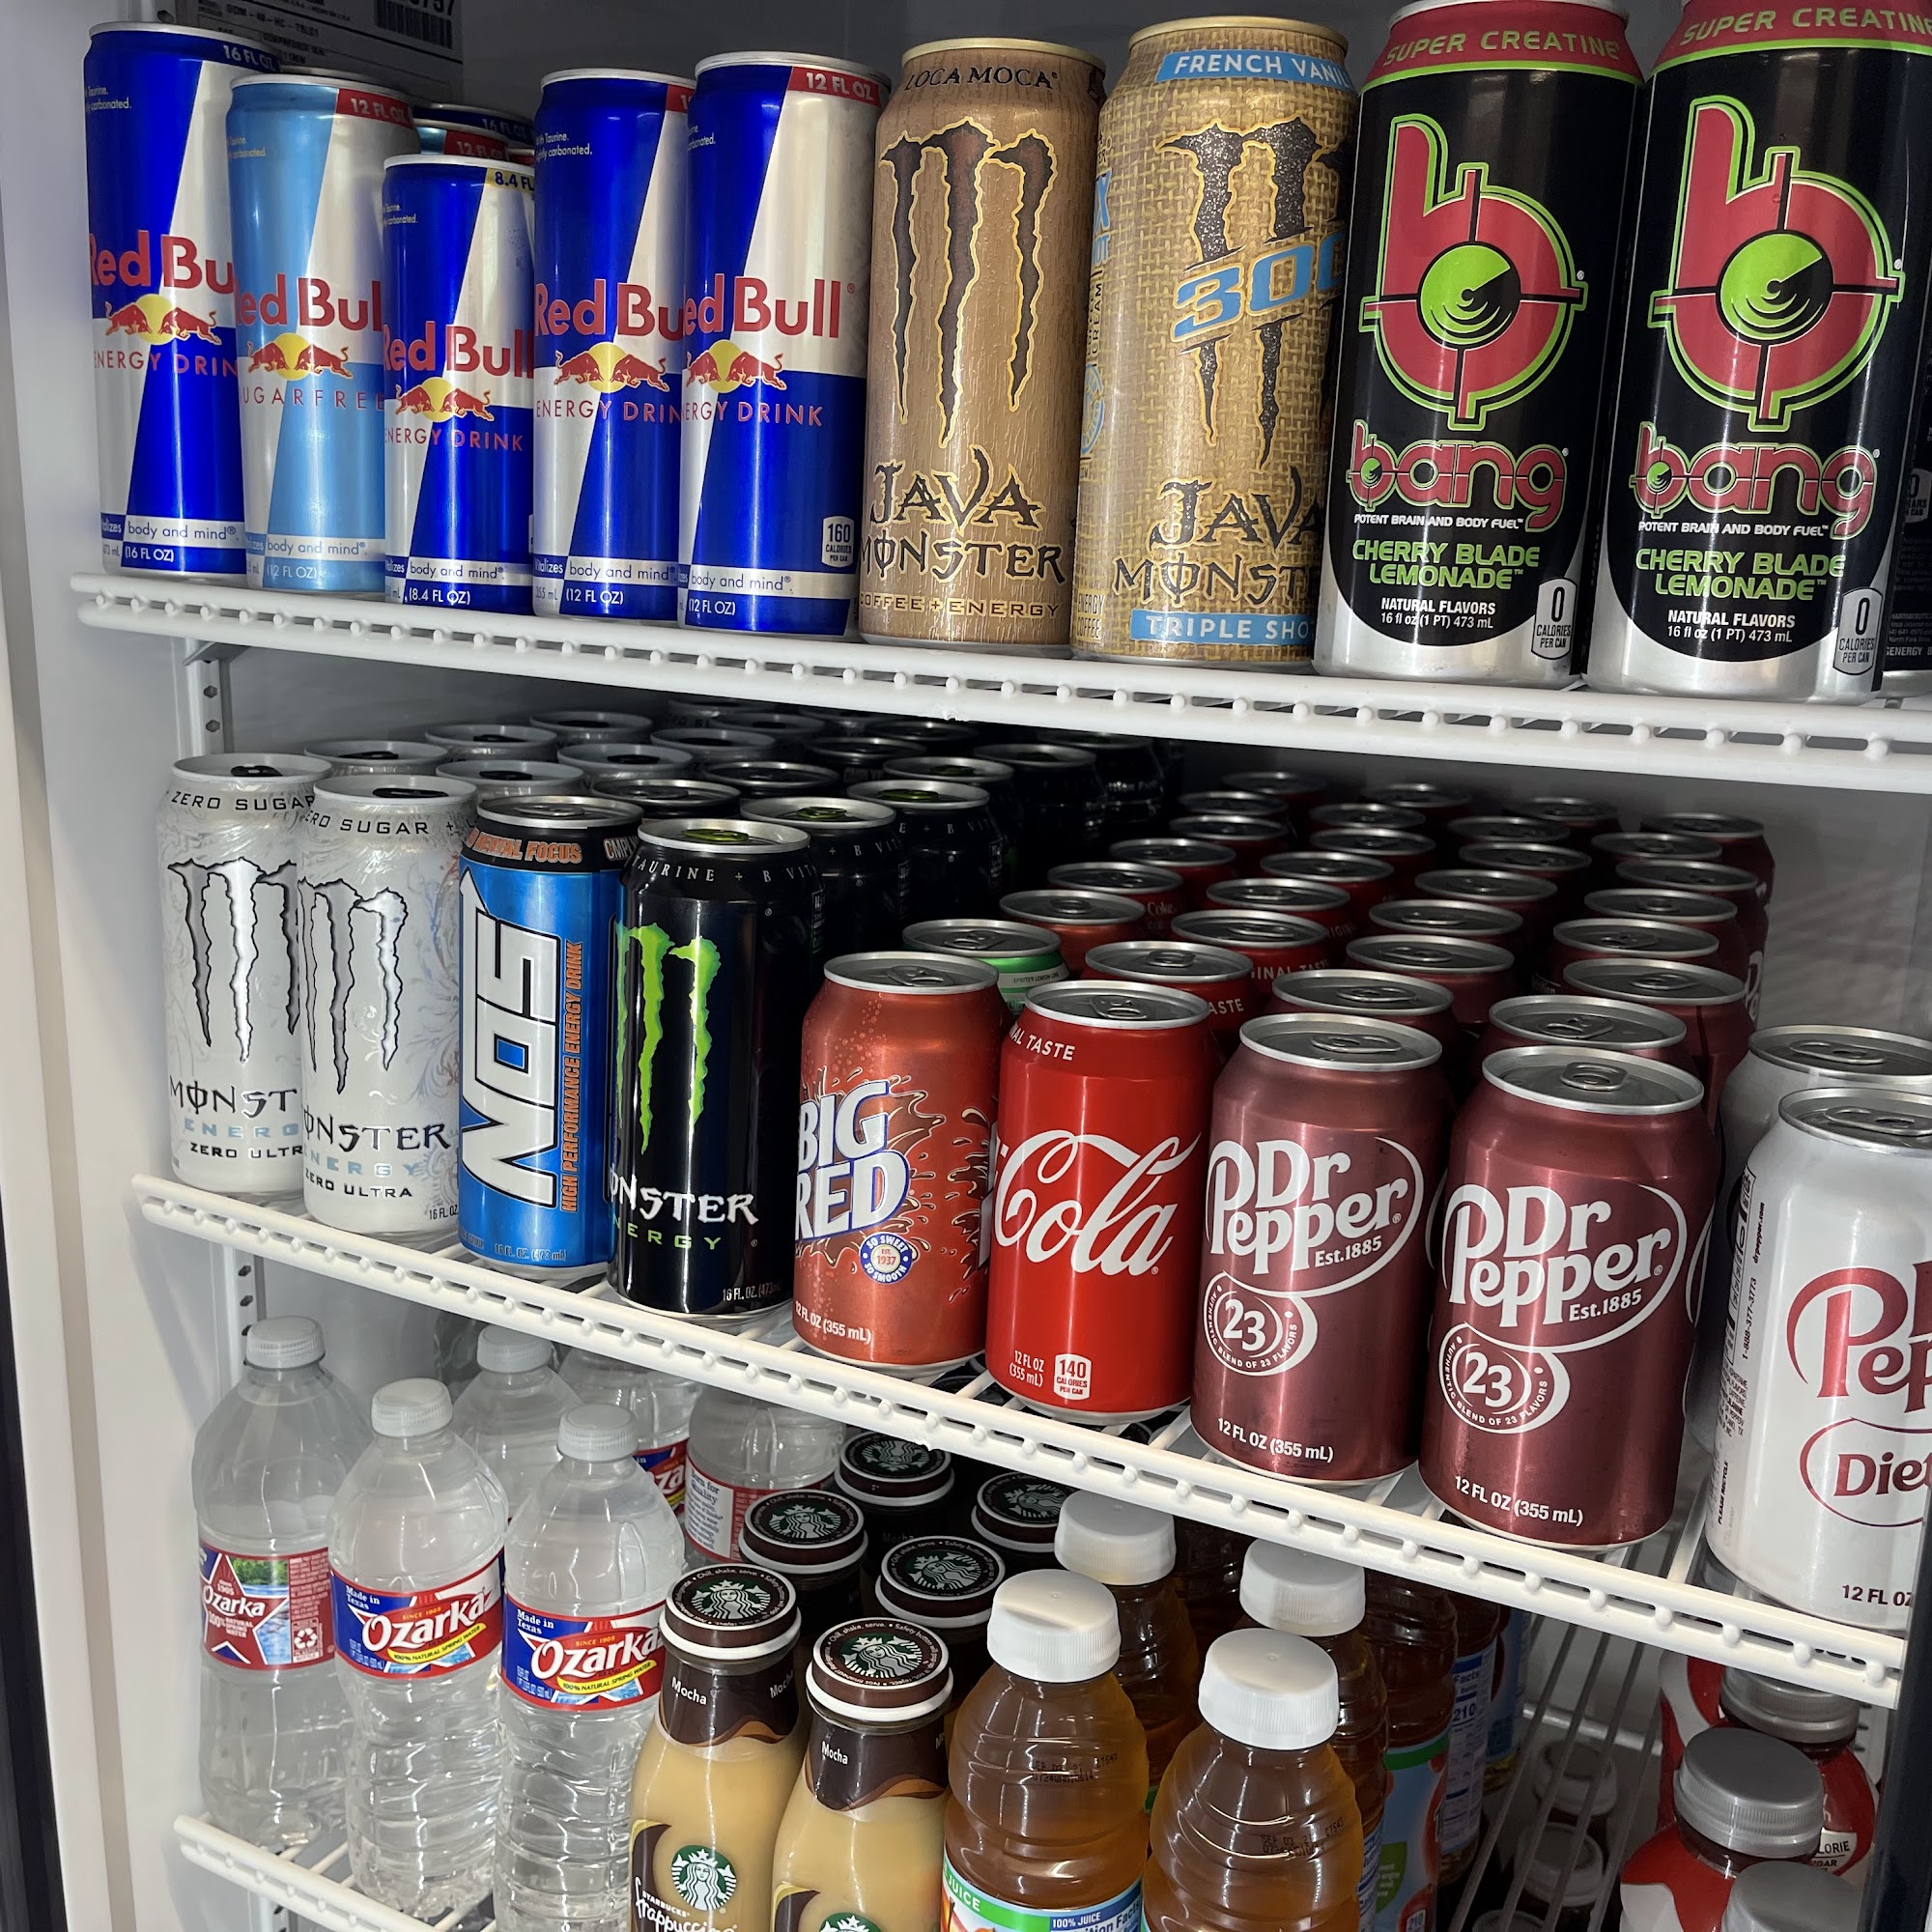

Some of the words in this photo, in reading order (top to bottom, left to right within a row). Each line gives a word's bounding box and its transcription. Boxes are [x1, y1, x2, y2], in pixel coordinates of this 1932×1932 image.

[1681, 10, 1775, 46] SUPER
[1384, 32, 1463, 64] SUPER
[1480, 30, 1618, 60] CREATINE
[1175, 53, 1282, 77] FRENCH
[806, 71, 827, 91] 12
[833, 77, 850, 95] FL
[903, 67, 961, 92] LOCA
[495, 171, 519, 188] 8.4
[534, 278, 607, 338] Red
[733, 275, 840, 339] Bull
[446, 325, 534, 380] Bull
[535, 399, 612, 421] ENERGY
[737, 401, 823, 427] DRINK
[451, 431, 524, 452] DRINK
[1346, 419, 1567, 532] bang
[1630, 420, 1878, 540] bang
[869, 443, 1044, 540] JAVA
[128, 519, 157, 541] body
[162, 521, 188, 539] and
[827, 523, 851, 544] 160
[1353, 514, 1389, 525] POTENT
[1391, 515, 1425, 526] BRAIN
[1456, 517, 1489, 528] BODY
[1638, 522, 1678, 532] POTENT
[1681, 522, 1719, 533] BRAIN
[1754, 524, 1790, 536] BODY
[268, 535, 293, 554] body
[298, 540, 323, 554] and
[825, 543, 851, 554] CALORIES
[858, 529, 1066, 584] MONSTER
[1352, 539, 1448, 564] CHERRY
[1455, 543, 1541, 568] BLADE
[410, 561, 437, 578] body
[569, 562, 601, 580] body
[606, 566, 632, 579] and
[1635, 548, 1745, 574] CHERRY
[1752, 552, 1846, 577] BLADE
[691, 572, 715, 590] body
[720, 576, 744, 588] and
[584, 590, 597, 604] FL
[702, 600, 713, 613] FL
[947, 598, 1060, 619] ENERGY
[1381, 598, 1435, 613] NATURAL
[1438, 600, 1495, 615] FLAVORS
[1551, 586, 1565, 623] 0
[1146, 614, 1263, 639] TRIPLE
[1380, 612, 1394, 624] 16
[1453, 615, 1474, 627] 473
[1477, 616, 1494, 628] mL
[1667, 610, 1729, 626] NATURAL
[1732, 611, 1796, 629] FLAVORS
[1856, 597, 1870, 636] 0
[1537, 624, 1571, 638] CALORIES
[1667, 625, 1681, 638] 16
[1748, 628, 1772, 641] 473
[1775, 629, 1793, 642] mL
[1839, 637, 1876, 652] CALORIES
[172, 790, 222, 810] ZERO
[340, 819, 431, 836] SUGAR
[473, 831, 524, 861] MENTAL
[525, 840, 582, 865] FOCUS
[632, 854, 716, 883] TAURINE
[1147, 900, 1175, 918] Coke
[565, 939, 584, 991] DRINK
[563, 992, 583, 1055] ENERGY
[460, 867, 562, 1208] NOS
[1026, 1032, 1075, 1062] TASTE
[560, 1056, 581, 1173] PERFORMANCE
[798, 1079, 891, 1173] BIG
[190, 1141, 238, 1159] ZERO
[305, 1167, 335, 1192] ZERO
[344, 1184, 413, 1198] ULTRA
[1256, 1139, 1351, 1208] Dr
[560, 1175, 579, 1213] HIGH
[795, 1149, 912, 1241] RED
[994, 1128, 1202, 1277] Cola
[1206, 1140, 1408, 1275] Pepper
[1506, 1185, 1612, 1258] Dr
[880, 1235, 909, 1254] SWEET
[1442, 1183, 1672, 1328] Pepper
[872, 1264, 908, 1283] SMOOTH
[876, 1255, 897, 1266] 1937
[1569, 1290, 1643, 1322] Est.1885
[1741, 1276, 1758, 1361] 1-888-377-3773
[823, 1319, 846, 1338] (355
[847, 1326, 873, 1346] mL)
[1223, 1298, 1266, 1351] 23
[1218, 1346, 1243, 1368] BLEND
[1272, 1322, 1298, 1362] FLAVORS
[1009, 1362, 1025, 1381] (355
[1023, 1353, 1032, 1369] FL
[1033, 1357, 1045, 1373] OZ
[1059, 1359, 1087, 1378] 140
[1056, 1377, 1088, 1388] CALORIES
[1463, 1351, 1513, 1408] 23
[1456, 1400, 1486, 1424] BLEND
[1519, 1380, 1548, 1421] FLAVORS
[1217, 1417, 1232, 1437] 12
[1233, 1424, 1246, 1445] FL
[1250, 1431, 1267, 1450] OZ
[1270, 1436, 1302, 1460] (355
[1305, 1444, 1334, 1463] mL)
[1720, 1461, 1729, 1494] RECYCLE
[1455, 1476, 1470, 1495] 12
[1471, 1484, 1489, 1504] FL
[1492, 1492, 1512, 1511] OZ
[1514, 1498, 1549, 1520] (355
[1552, 1506, 1584, 1526] mL)
[203, 1585, 266, 1618] Ozarka
[345, 1585, 369, 1601] Made
[346, 1595, 370, 1610] Texas
[1842, 1585, 1863, 1601] 12
[1867, 1587, 1889, 1605] FL
[361, 1591, 486, 1652] Ozarka
[517, 1608, 541, 1626] Made
[517, 1618, 543, 1634] Texas
[895, 1622, 917, 1635] Safety
[412, 1648, 440, 1662] NATURAL
[464, 1625, 482, 1640] WATER
[530, 1627, 661, 1680] Ozarka
[581, 1680, 611, 1691] NATURAL
[611, 1672, 634, 1686] SPRING
[634, 1662, 652, 1676] WATER
[671, 1676, 708, 1706] Mocha
[1452, 1703, 1477, 1722] 210
[821, 1740, 848, 1766] Mocha
[1817, 1840, 1851, 1855] ORIE
[947, 1877, 981, 1913] JUICE
[1052, 1918, 1077, 1928] 100%
[1077, 1913, 1102, 1927] JUICE
[1407, 1913, 1425, 1930] 210
